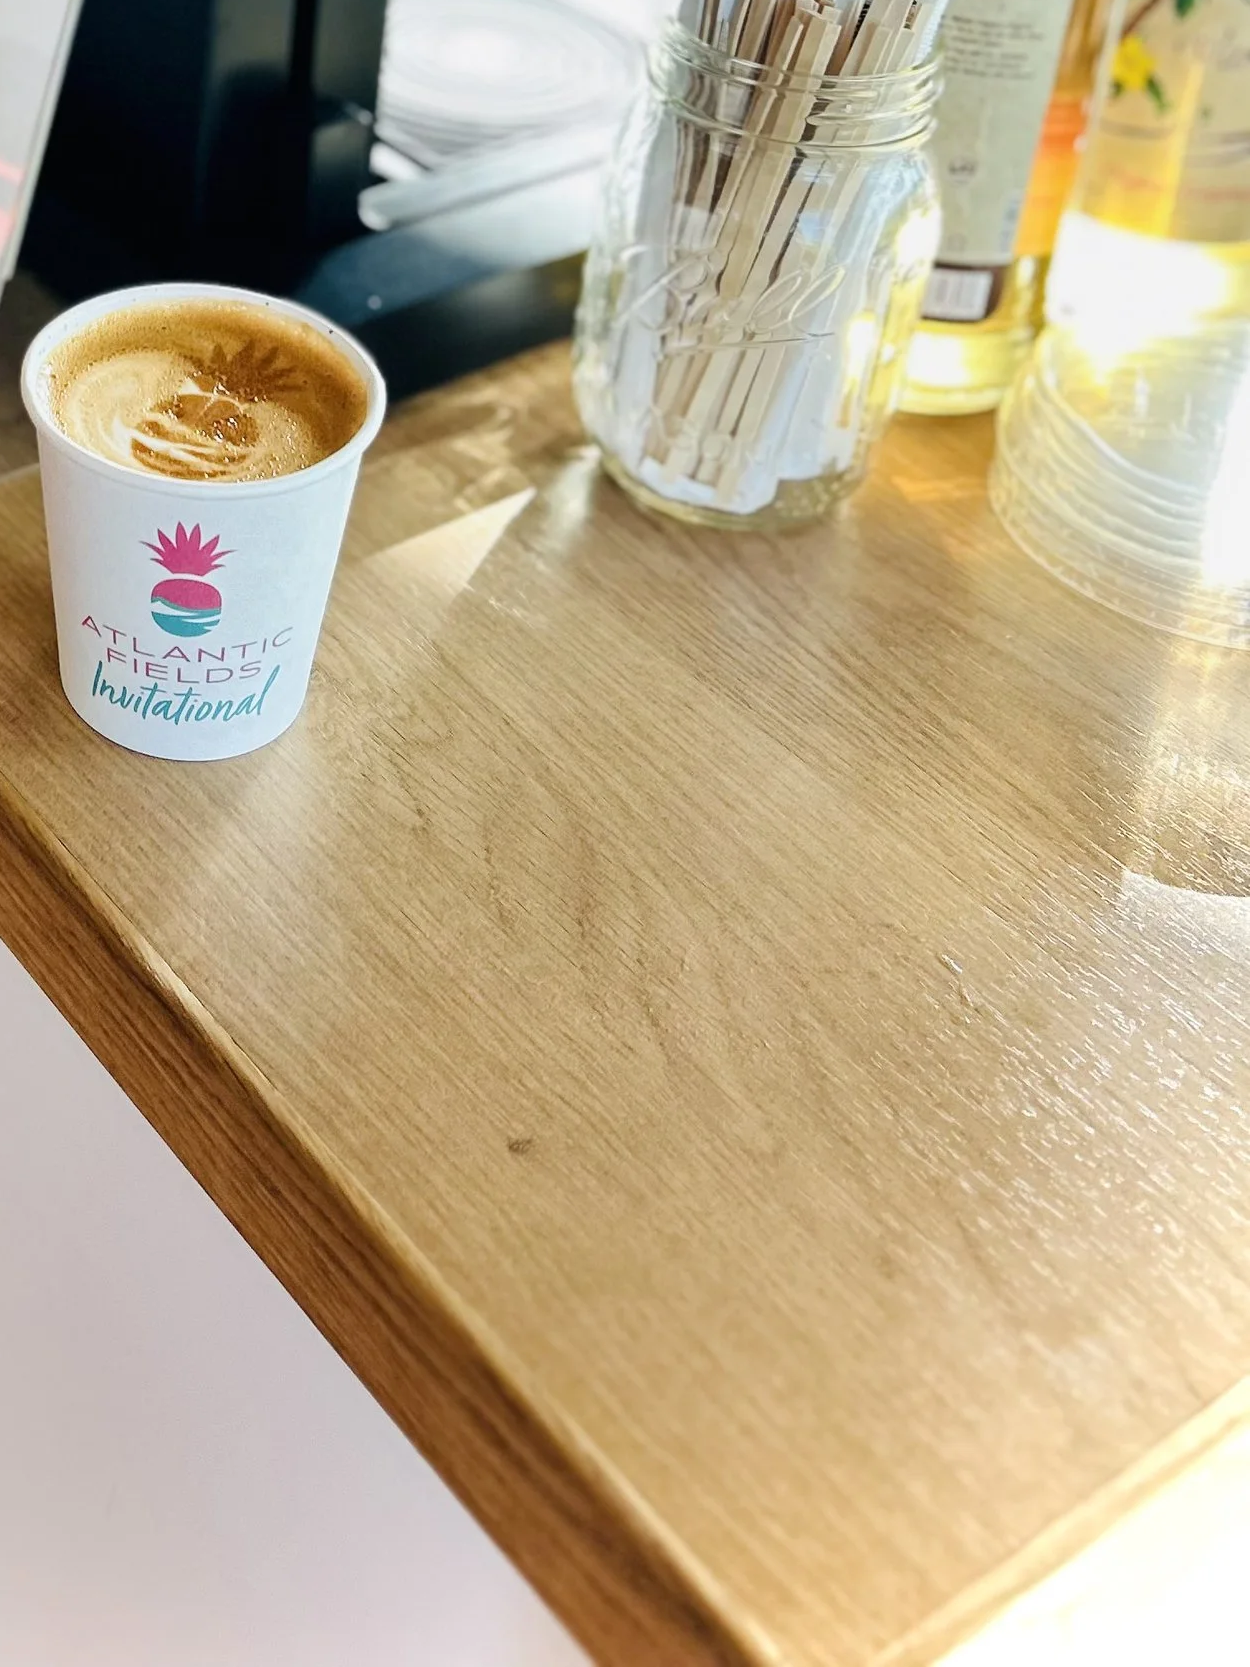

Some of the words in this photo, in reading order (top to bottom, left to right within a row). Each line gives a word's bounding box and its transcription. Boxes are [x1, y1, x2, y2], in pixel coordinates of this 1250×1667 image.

[80, 613, 295, 664] ATLANTIC
[90, 655, 282, 727] Invitational
[105, 646, 263, 685] FIELDS
